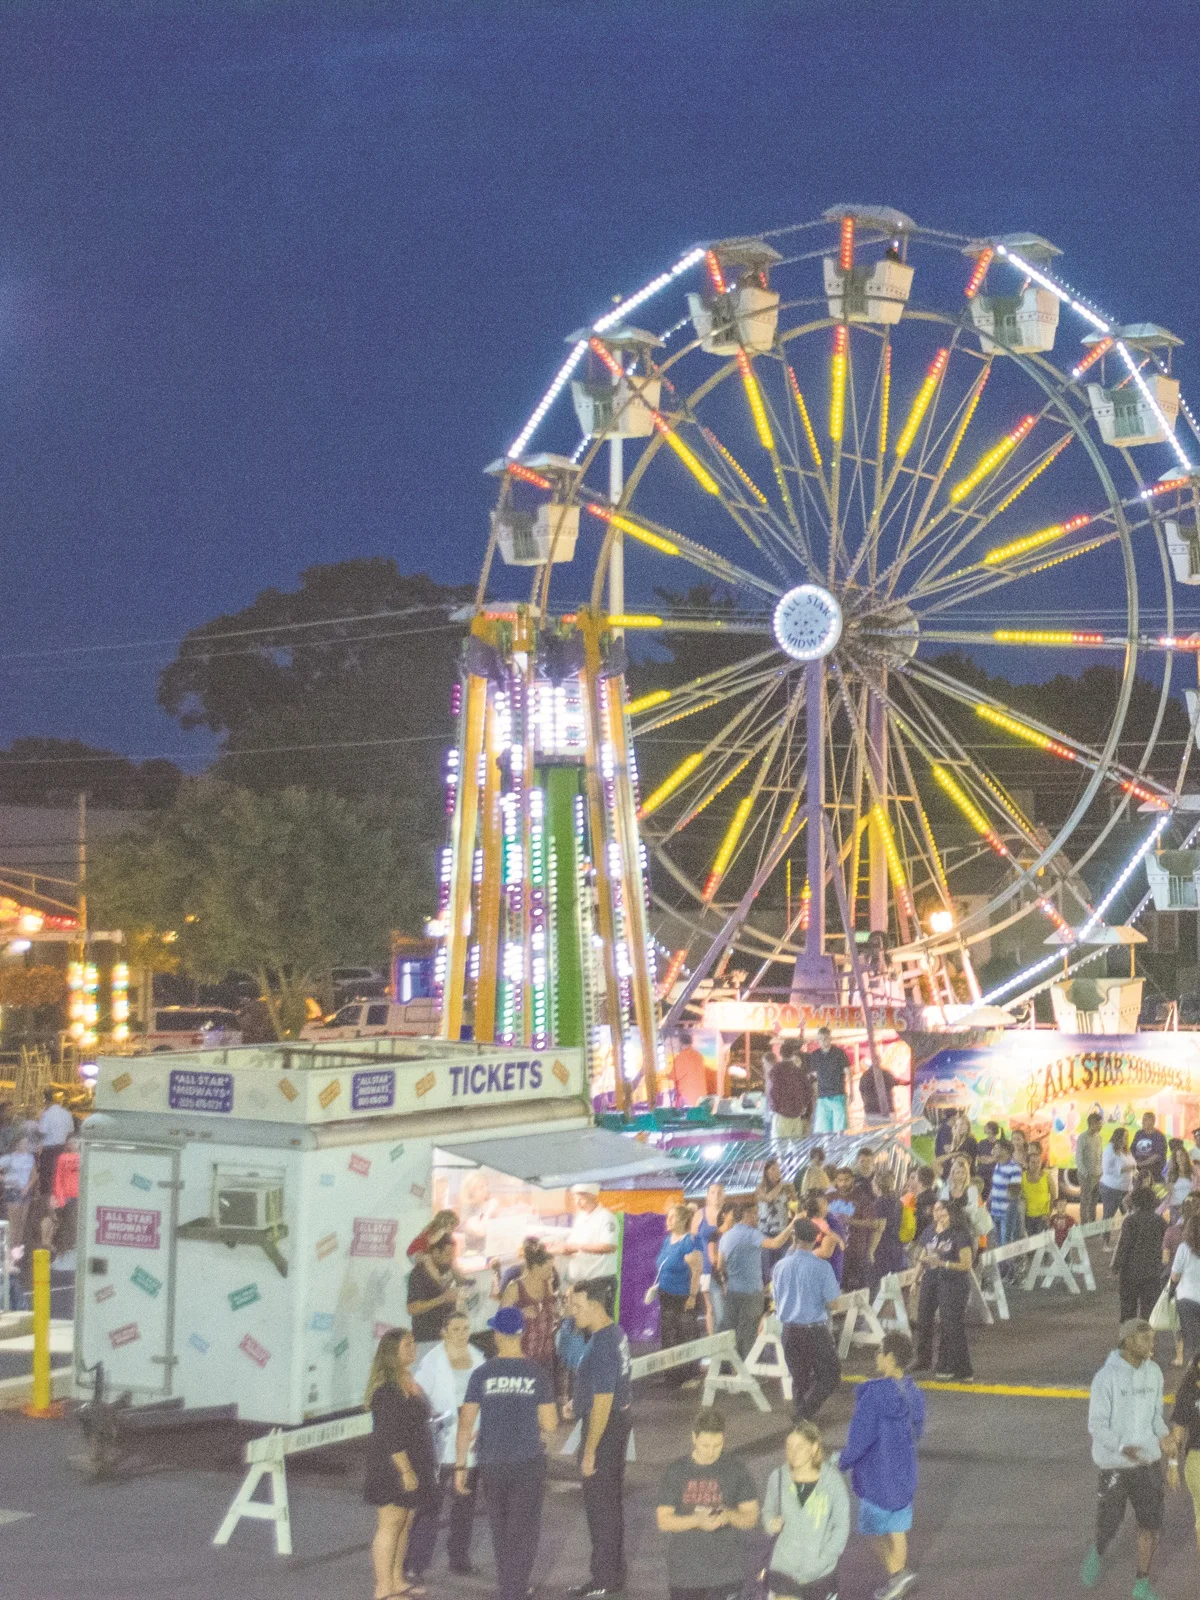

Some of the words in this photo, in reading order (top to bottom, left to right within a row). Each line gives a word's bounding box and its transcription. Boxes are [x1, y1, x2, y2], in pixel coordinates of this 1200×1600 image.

[783, 598, 800, 620] ALL
[806, 594, 831, 617] STAR
[179, 1074, 196, 1085] ALL
[198, 1075, 225, 1086] STAR
[449, 1059, 543, 1096] TICKETS
[1043, 1054, 1080, 1104] ALL
[1080, 1052, 1124, 1089] STAR
[176, 1085, 227, 1098] MIDWAYS
[106, 1212, 123, 1222] ALL
[125, 1213, 153, 1224] STAR
[107, 1222, 149, 1234] MIDWAY
[486, 1376, 536, 1390] FDNY
